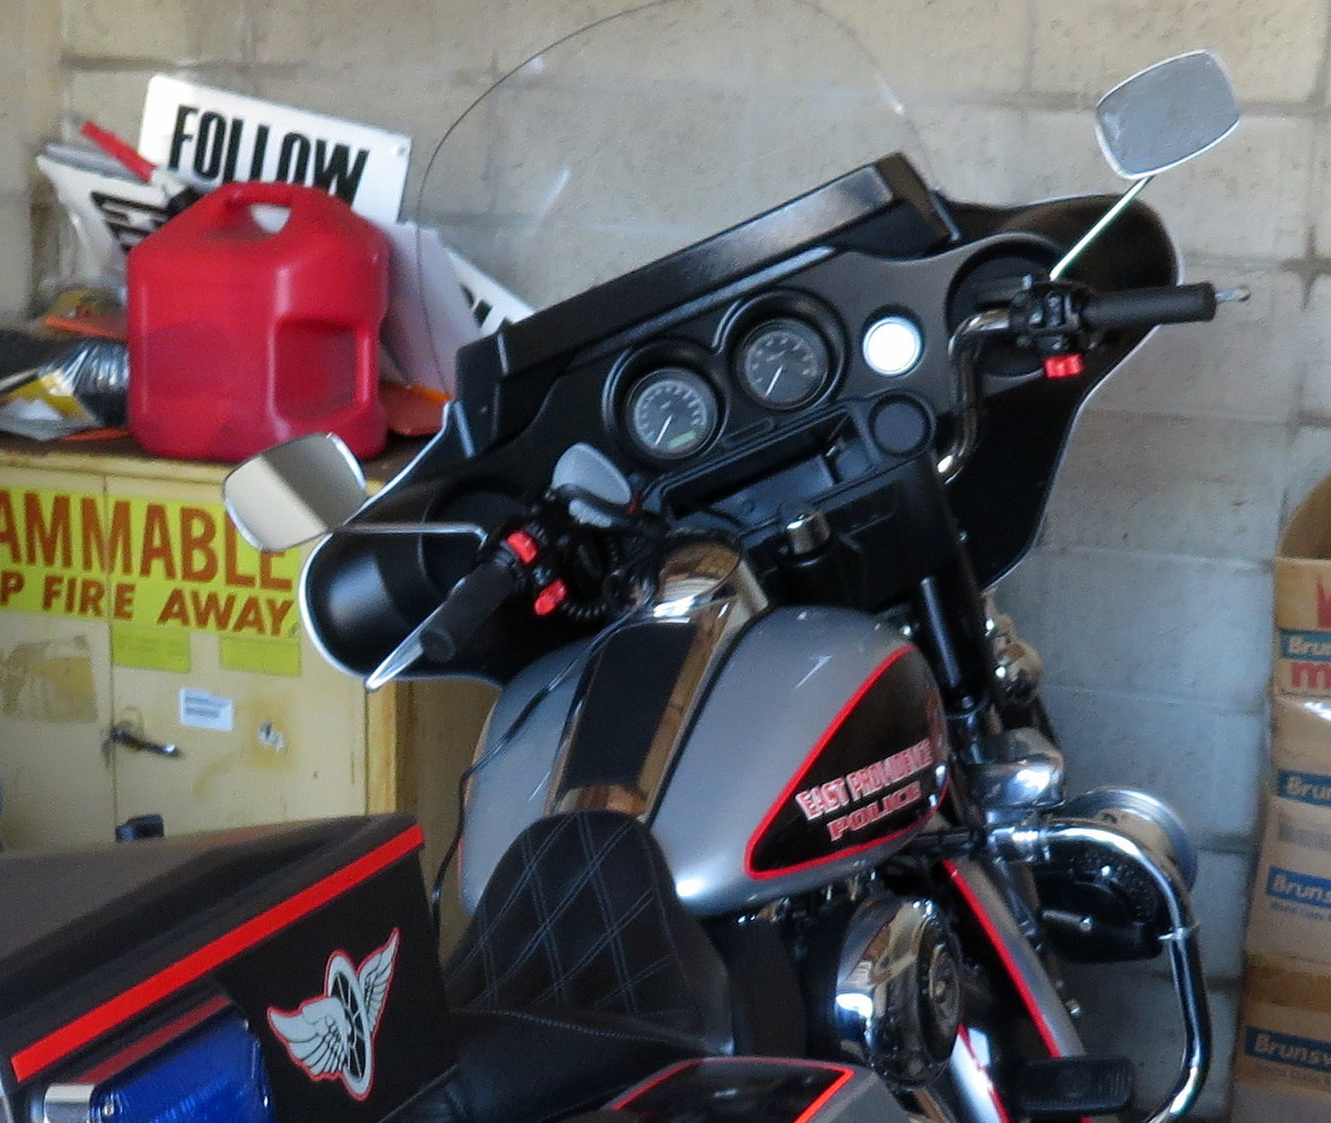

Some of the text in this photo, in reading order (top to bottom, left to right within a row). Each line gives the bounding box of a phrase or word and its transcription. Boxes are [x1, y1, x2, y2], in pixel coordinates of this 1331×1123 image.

[42, 574, 136, 620] FIRE
[157, 588, 294, 638] AWAY
[826, 780, 922, 843] POLICE
